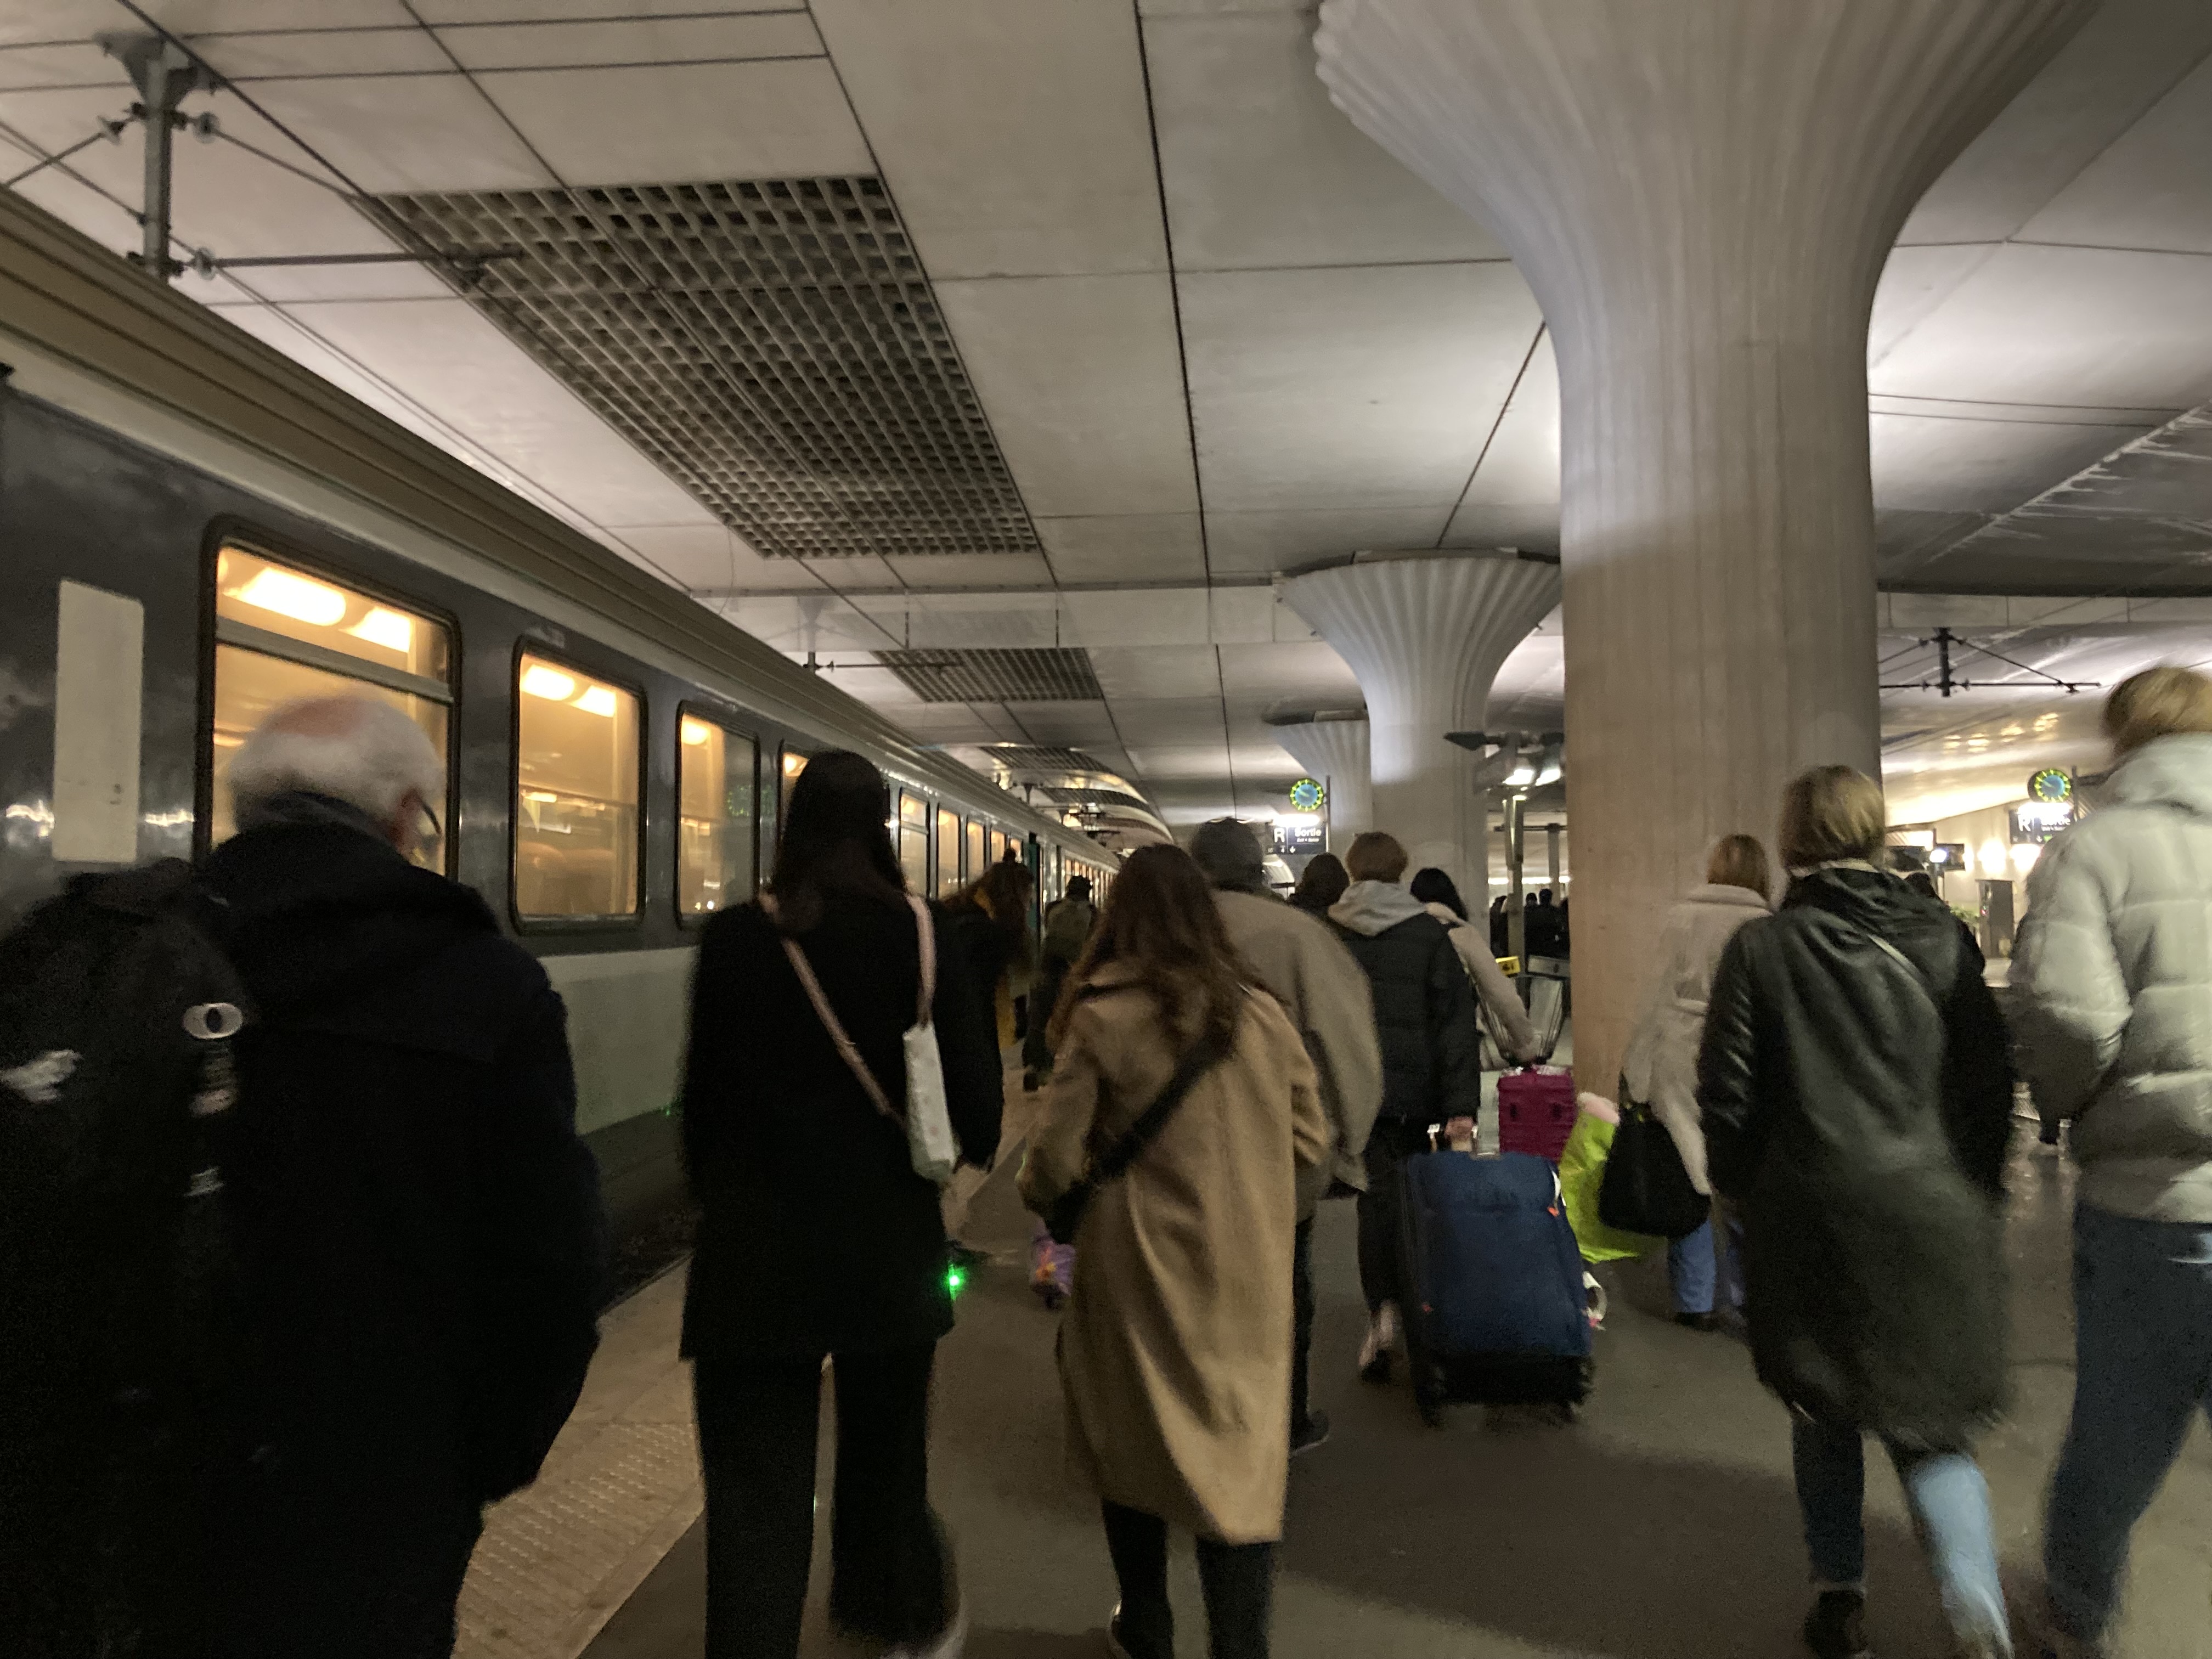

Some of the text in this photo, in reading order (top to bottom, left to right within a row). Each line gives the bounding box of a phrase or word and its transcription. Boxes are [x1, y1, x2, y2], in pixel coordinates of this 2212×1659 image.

[2018, 814, 2031, 831] R
[1274, 827, 1285, 843] R
[1295, 827, 1322, 837] Sortie
